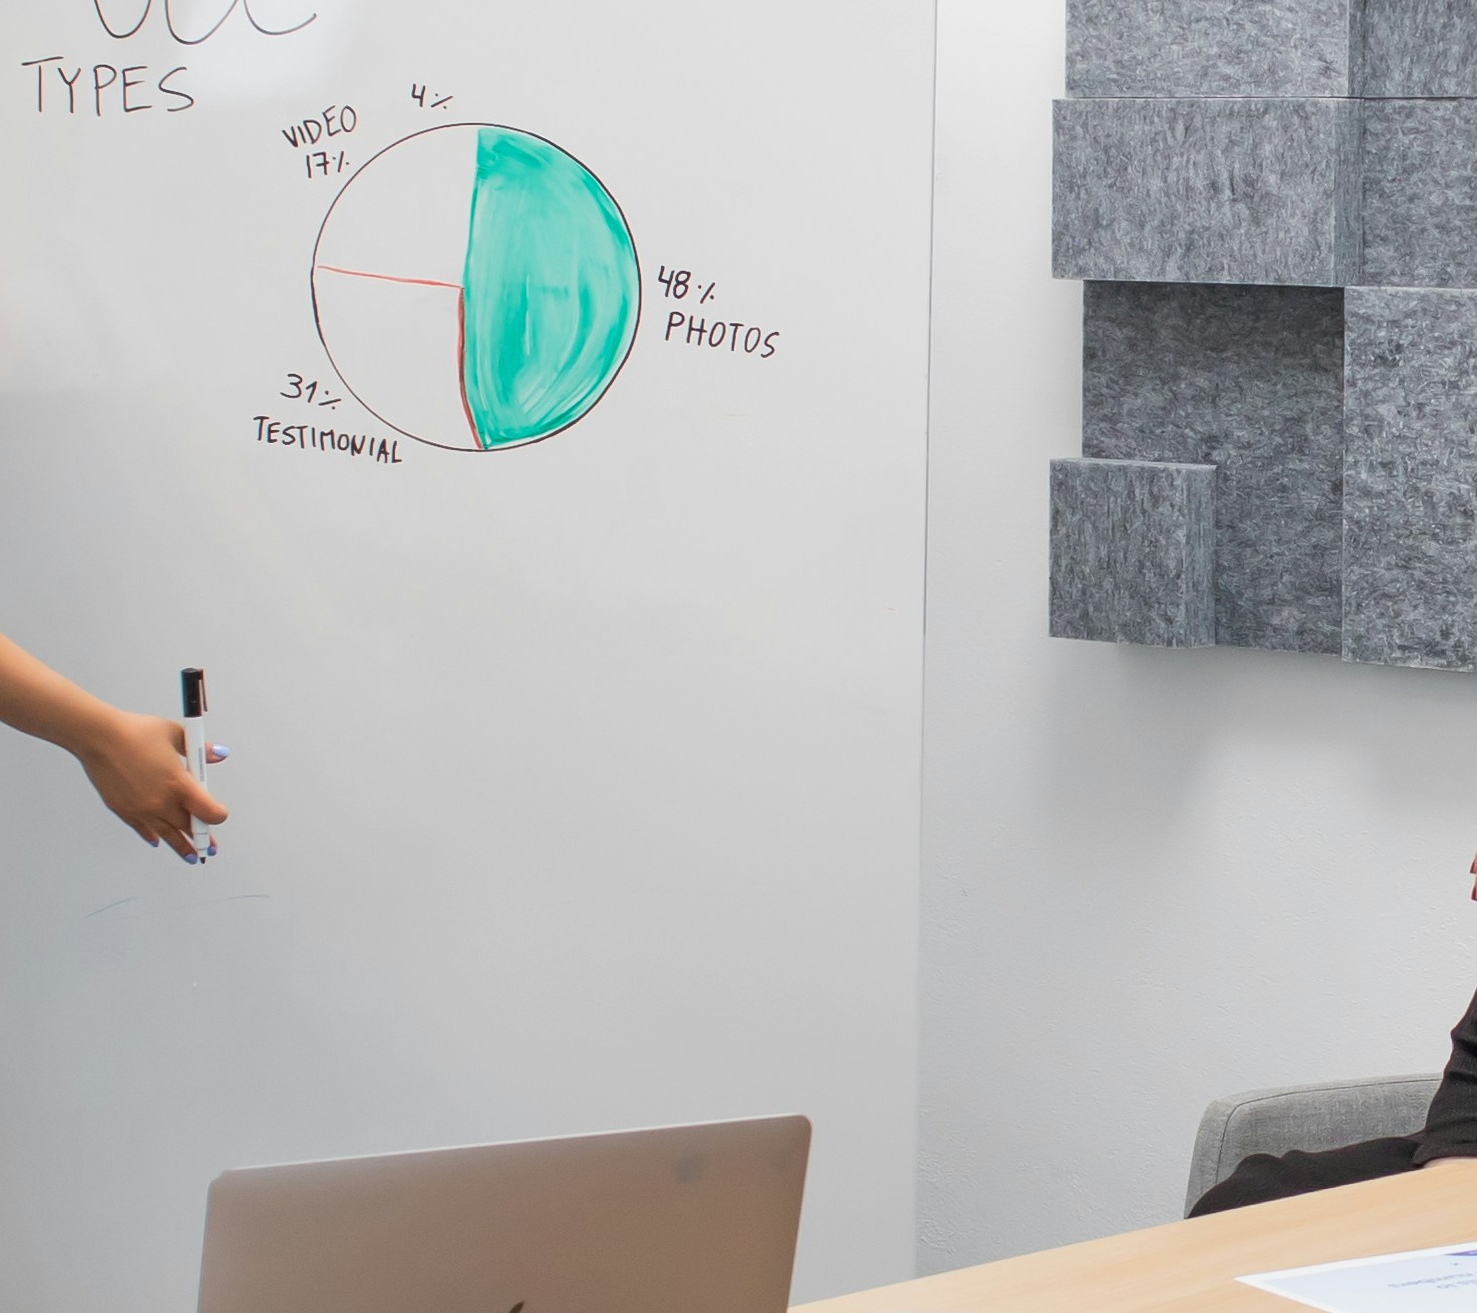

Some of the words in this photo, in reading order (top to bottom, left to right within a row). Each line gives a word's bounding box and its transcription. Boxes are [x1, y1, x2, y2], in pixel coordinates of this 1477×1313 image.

[21, 55, 195, 117] TYPES
[411, 83, 454, 110] 4%
[281, 104, 357, 148] VIDEO
[305, 150, 351, 179] 17%
[657, 264, 716, 305] 48%
[664, 310, 781, 359] PHOTOS
[279, 373, 343, 411] 31%
[252, 415, 403, 464] TESTIMONIAL
